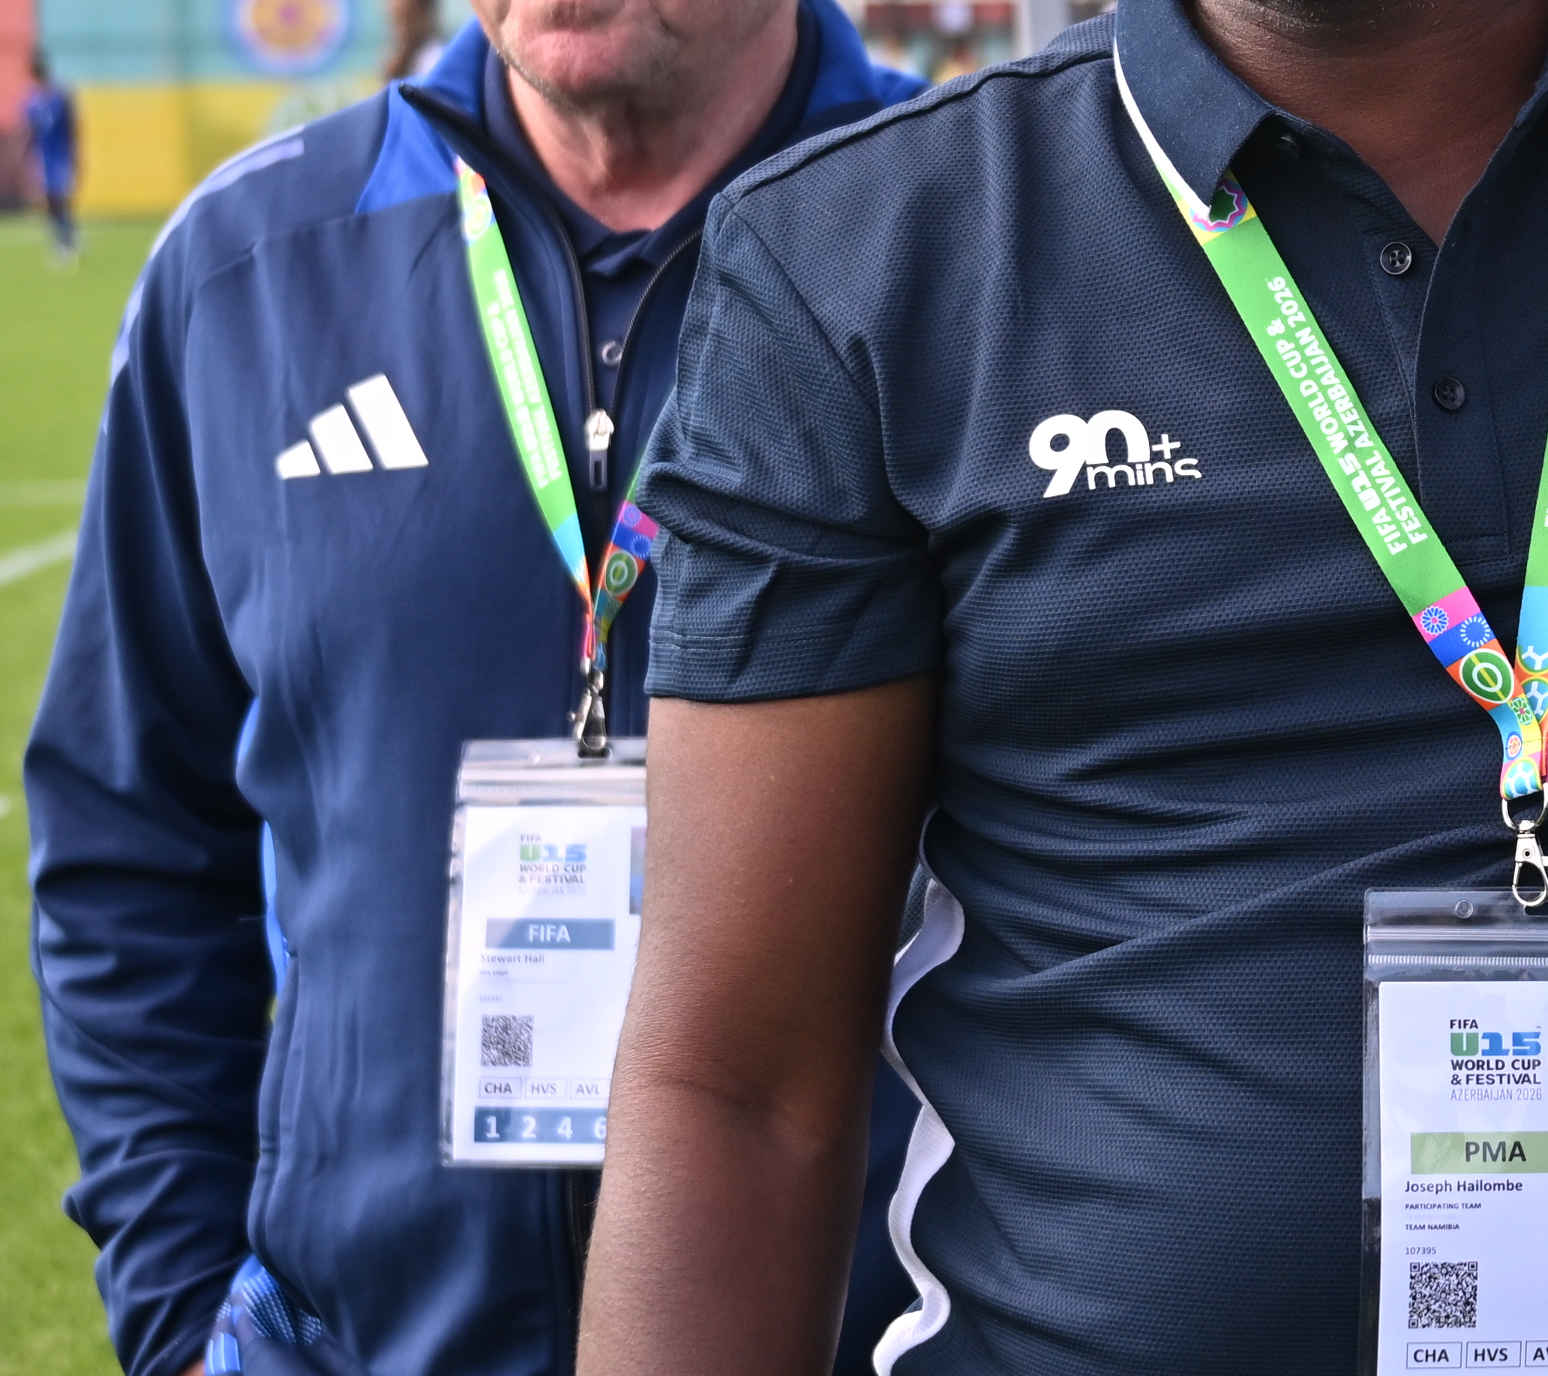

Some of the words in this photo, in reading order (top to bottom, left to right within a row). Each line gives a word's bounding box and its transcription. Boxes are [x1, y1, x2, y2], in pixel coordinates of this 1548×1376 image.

[1267, 277, 1306, 328] 2026
[1266, 318, 1285, 336] &
[1276, 340, 1307, 378] CUP
[1295, 327, 1374, 448] AZERBAIJAN
[1300, 380, 1348, 455] WORLD
[1086, 457, 1202, 490] mins
[1337, 453, 1381, 511] U15
[1365, 450, 1428, 544] FESTIVAL
[1372, 507, 1407, 555] FIFA
[520, 834, 542, 842] FIFA
[520, 844, 587, 862] U15
[520, 864, 559, 873] WORLD
[564, 864, 587, 873] CUP
[529, 875, 585, 884] FESTIVAL
[529, 924, 571, 942] FIFA
[481, 954, 521, 963] Stewart
[525, 954, 545, 963] Hall
[1450, 1019, 1479, 1029] FIFA
[1450, 1031, 1541, 1056] U15
[1450, 1059, 1505, 1071] WORLD
[1511, 1059, 1541, 1071] CUP
[1450, 1073, 1462, 1085] &
[1465, 1073, 1541, 1085] FESTIVAL
[484, 1082, 512, 1094] CHA
[531, 1083, 557, 1094] HVS
[576, 1083, 601, 1095] AVL
[1450, 1087, 1513, 1101] AZERBAIJAN
[1517, 1087, 1542, 1101] 2026
[486, 1116, 500, 1138] 1
[522, 1116, 537, 1138] 2
[557, 1116, 573, 1139] 4
[594, 1117, 607, 1139] 6
[1464, 1141, 1527, 1163] PMA
[1405, 1180, 1452, 1194] Joseph
[1457, 1179, 1523, 1192] Hailombe
[1427, 1223, 1460, 1231] NAMIBIA
[1405, 1246, 1437, 1255] 107395
[1413, 1348, 1450, 1363] CHA
[1474, 1347, 1508, 1362] HVS
